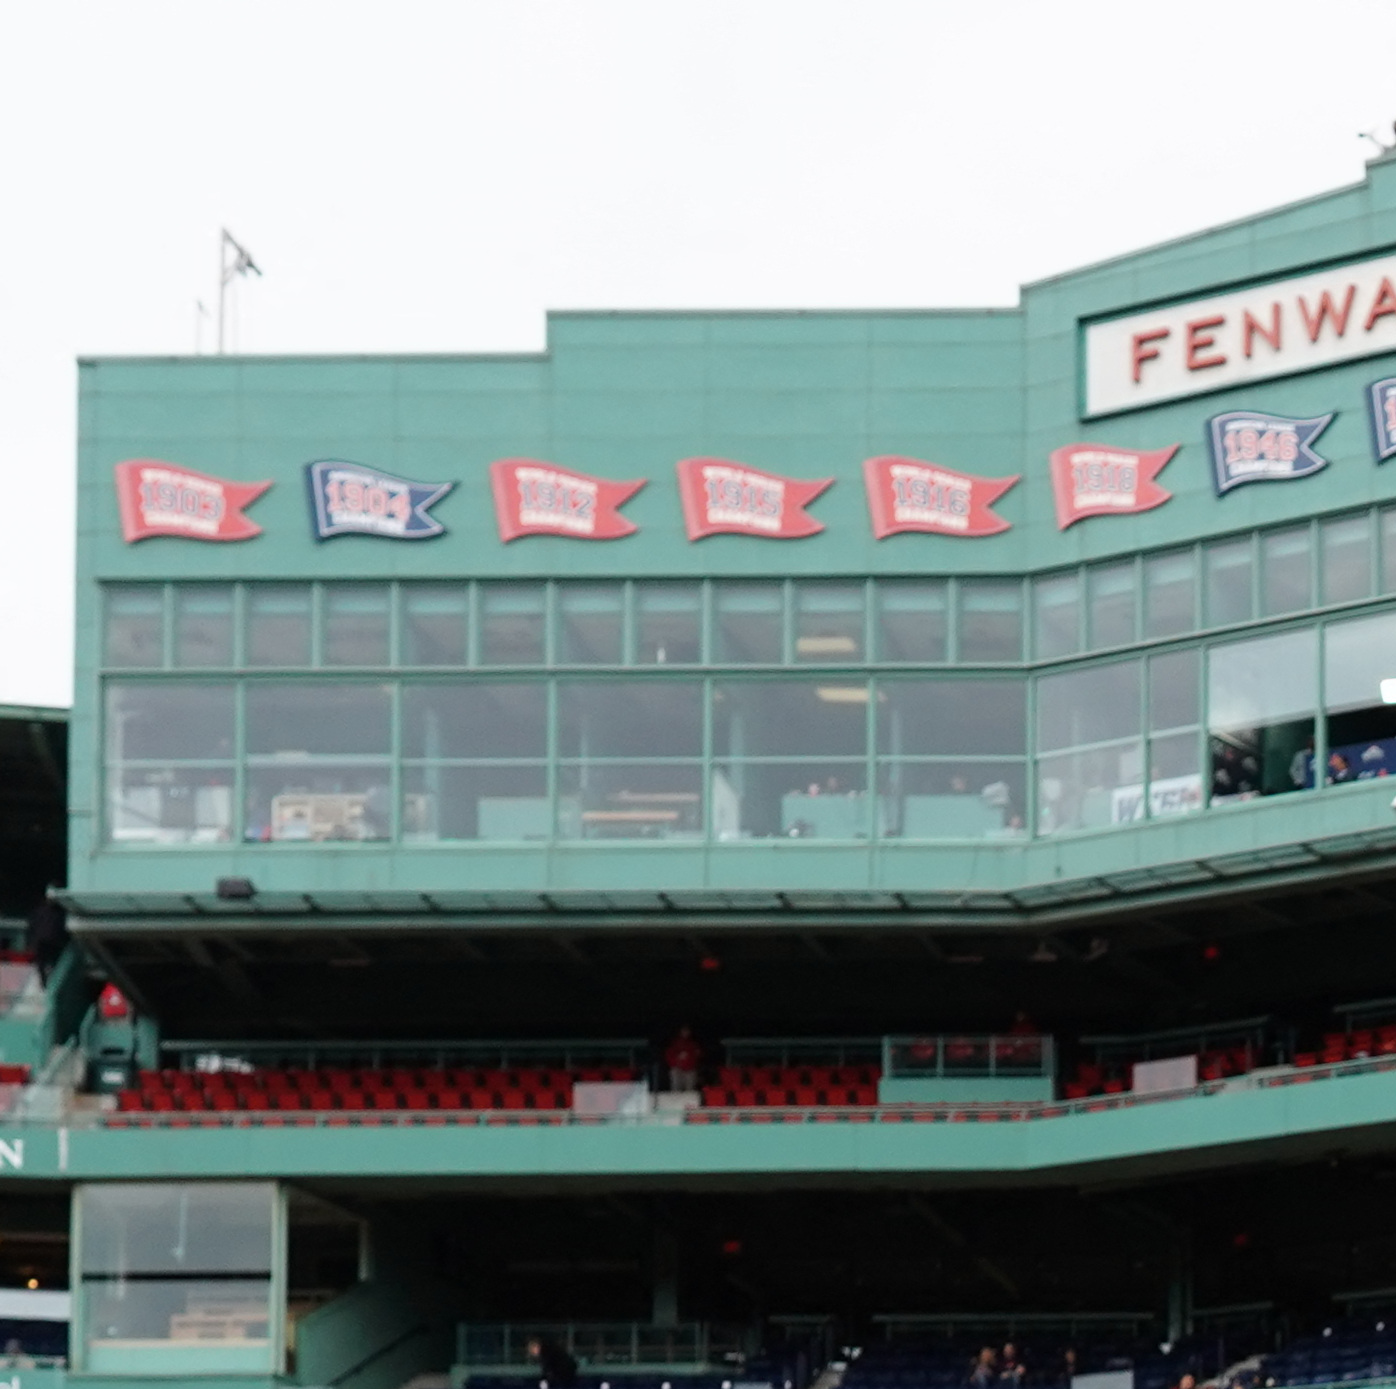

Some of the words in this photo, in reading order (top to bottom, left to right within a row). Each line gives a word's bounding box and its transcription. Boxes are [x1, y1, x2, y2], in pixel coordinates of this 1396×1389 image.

[1223, 430, 1298, 463] 1946
[520, 479, 594, 520] 1912
[707, 478, 784, 516] 1915
